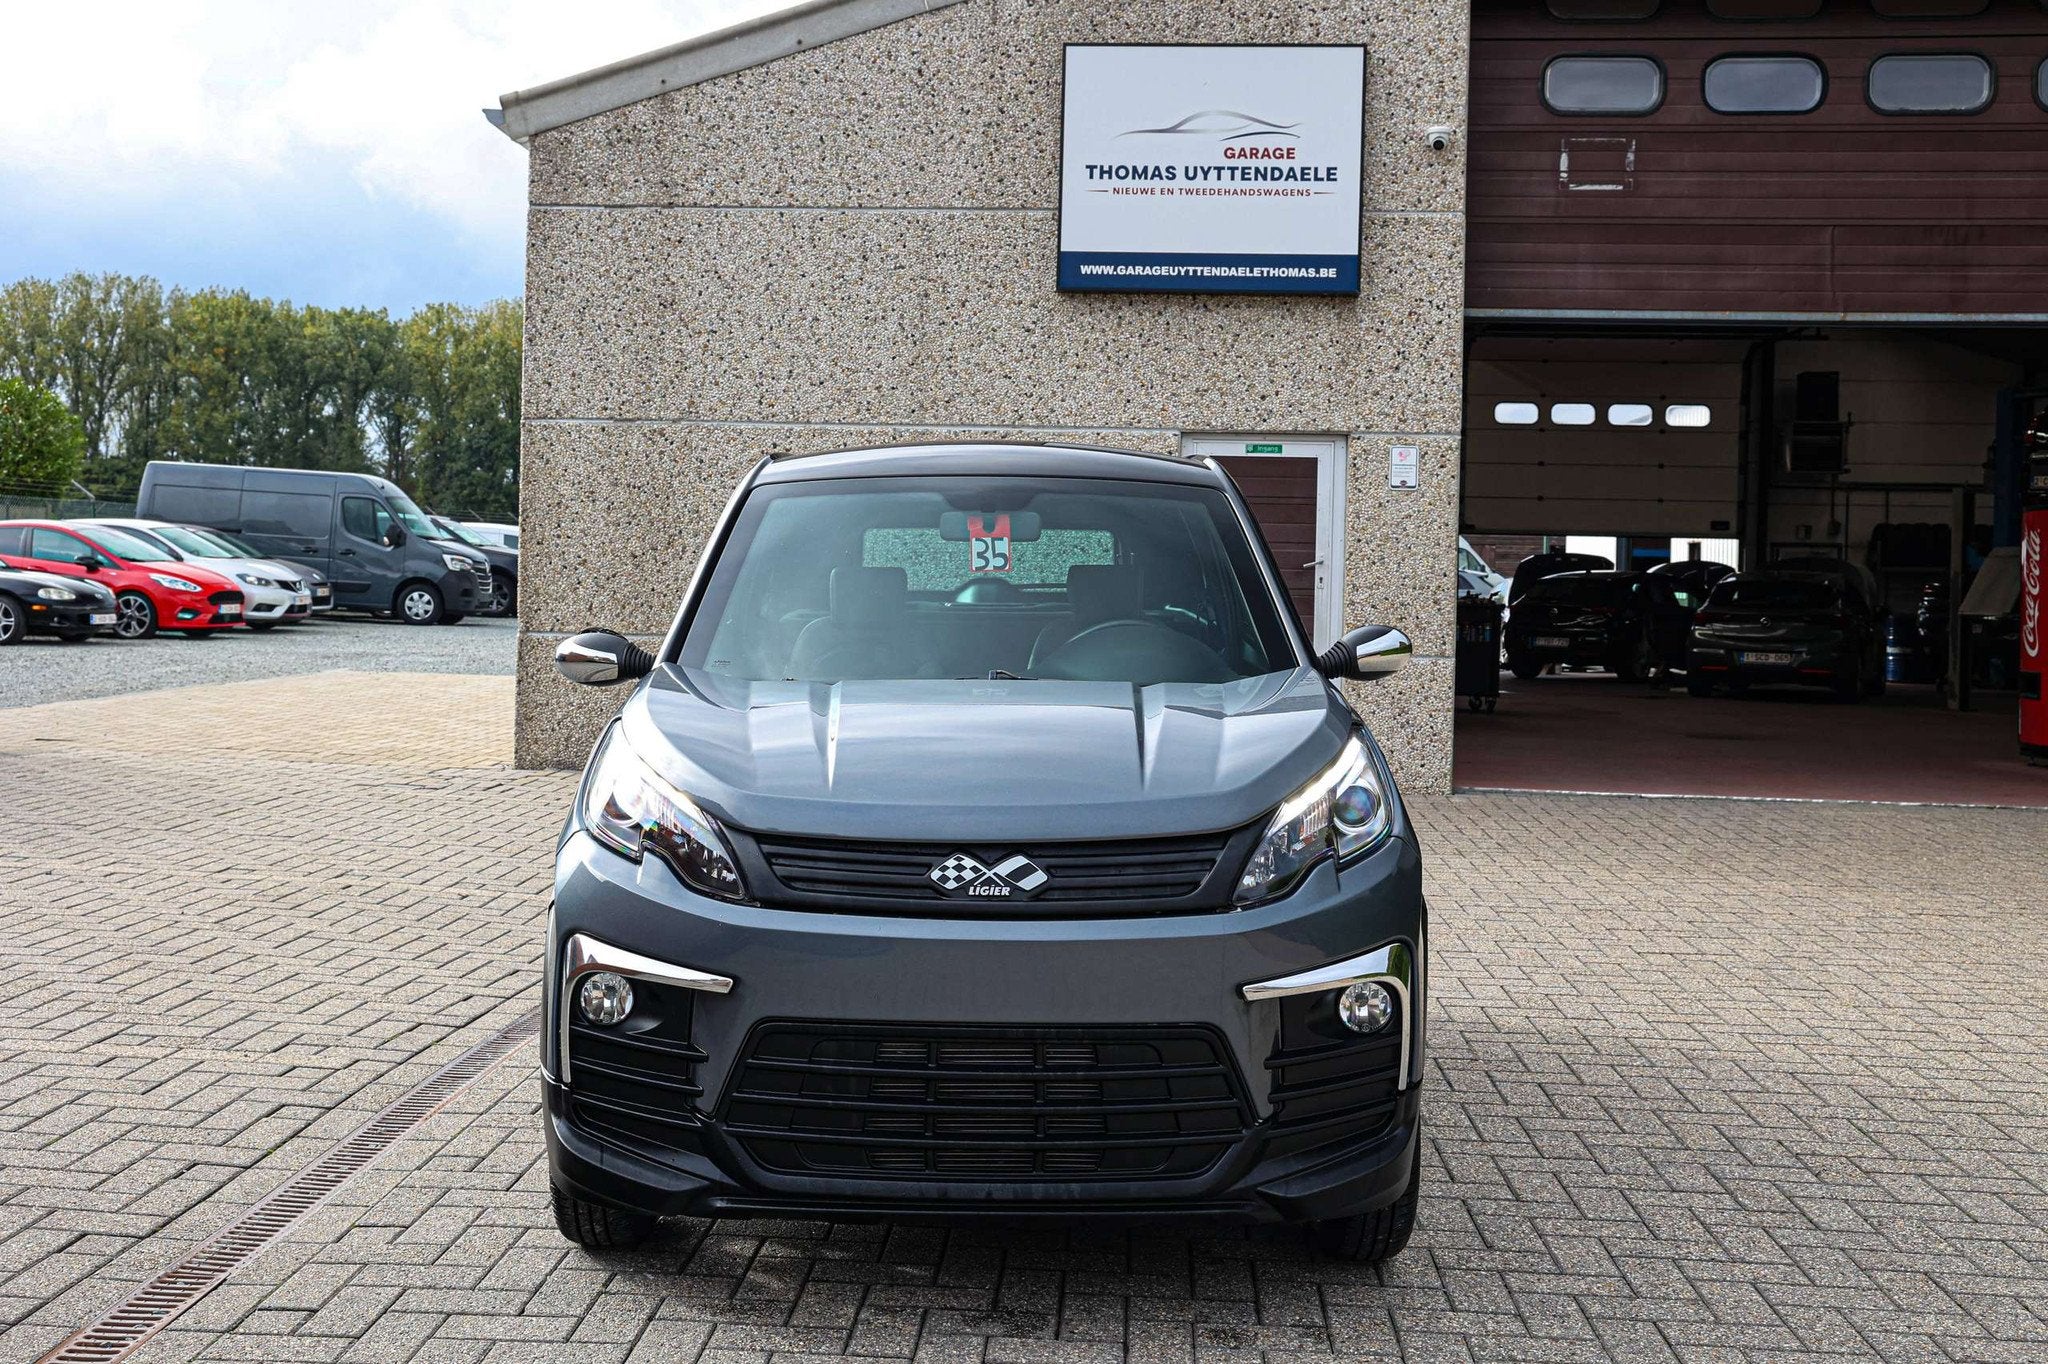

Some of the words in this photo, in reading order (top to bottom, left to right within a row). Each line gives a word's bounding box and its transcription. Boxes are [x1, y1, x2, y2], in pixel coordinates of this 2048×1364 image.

[1223, 147, 1296, 160] GARAGE
[1085, 164, 1177, 181] THOMAS
[1184, 165, 1338, 183] UYTTENDAELE
[1112, 187, 1156, 196] NIEUWE
[1160, 187, 1174, 196] EN
[1178, 188, 1311, 197] TWEEDEHANDSWAGENS
[1080, 264, 1337, 279] WWW.GARAGEUYTTENDAELETHOMAS.BE
[974, 537, 1008, 571] 35
[968, 885, 1010, 896] LIGIER
